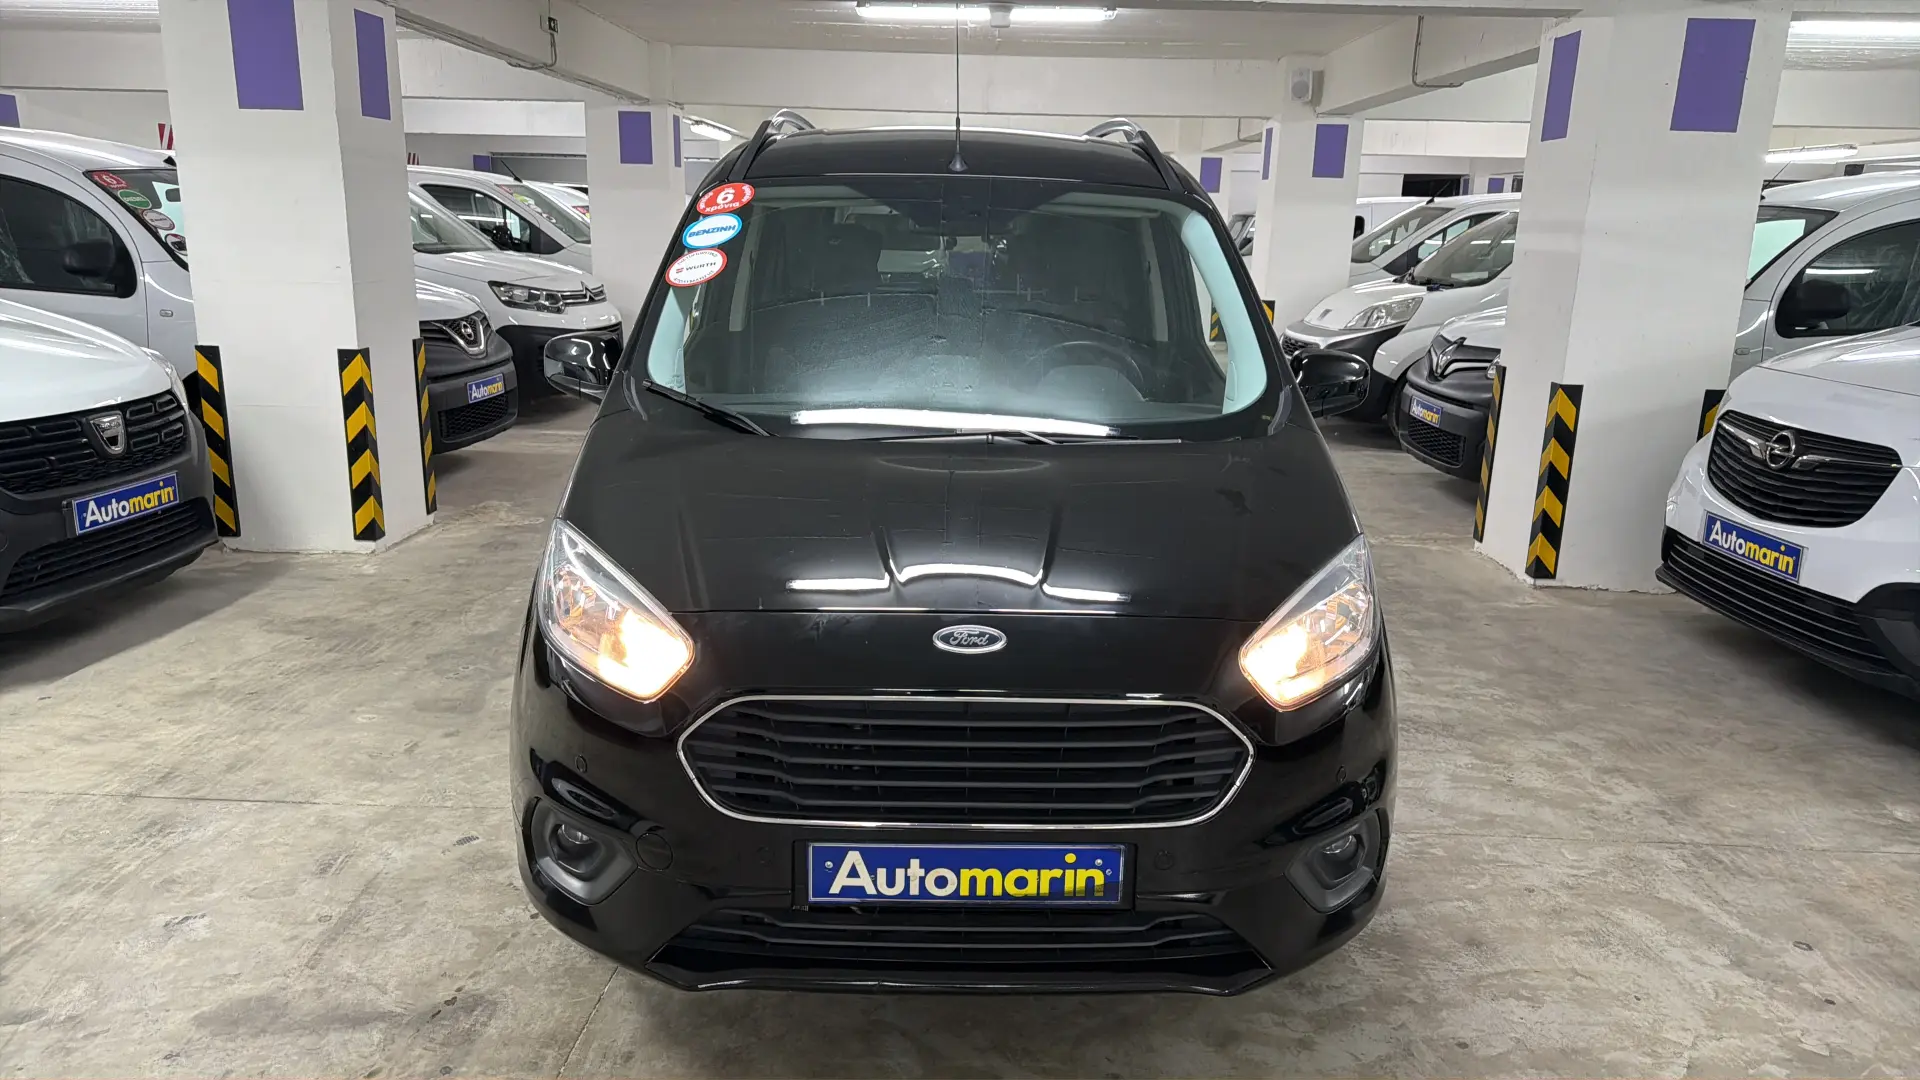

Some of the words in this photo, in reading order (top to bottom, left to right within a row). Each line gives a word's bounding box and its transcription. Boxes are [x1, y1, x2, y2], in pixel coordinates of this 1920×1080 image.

[716, 189, 735, 204] 6
[85, 481, 174, 528] Automarin
[1708, 520, 1794, 575] Automarin
[949, 629, 990, 646] Ford
[828, 851, 1104, 897] Automarin
